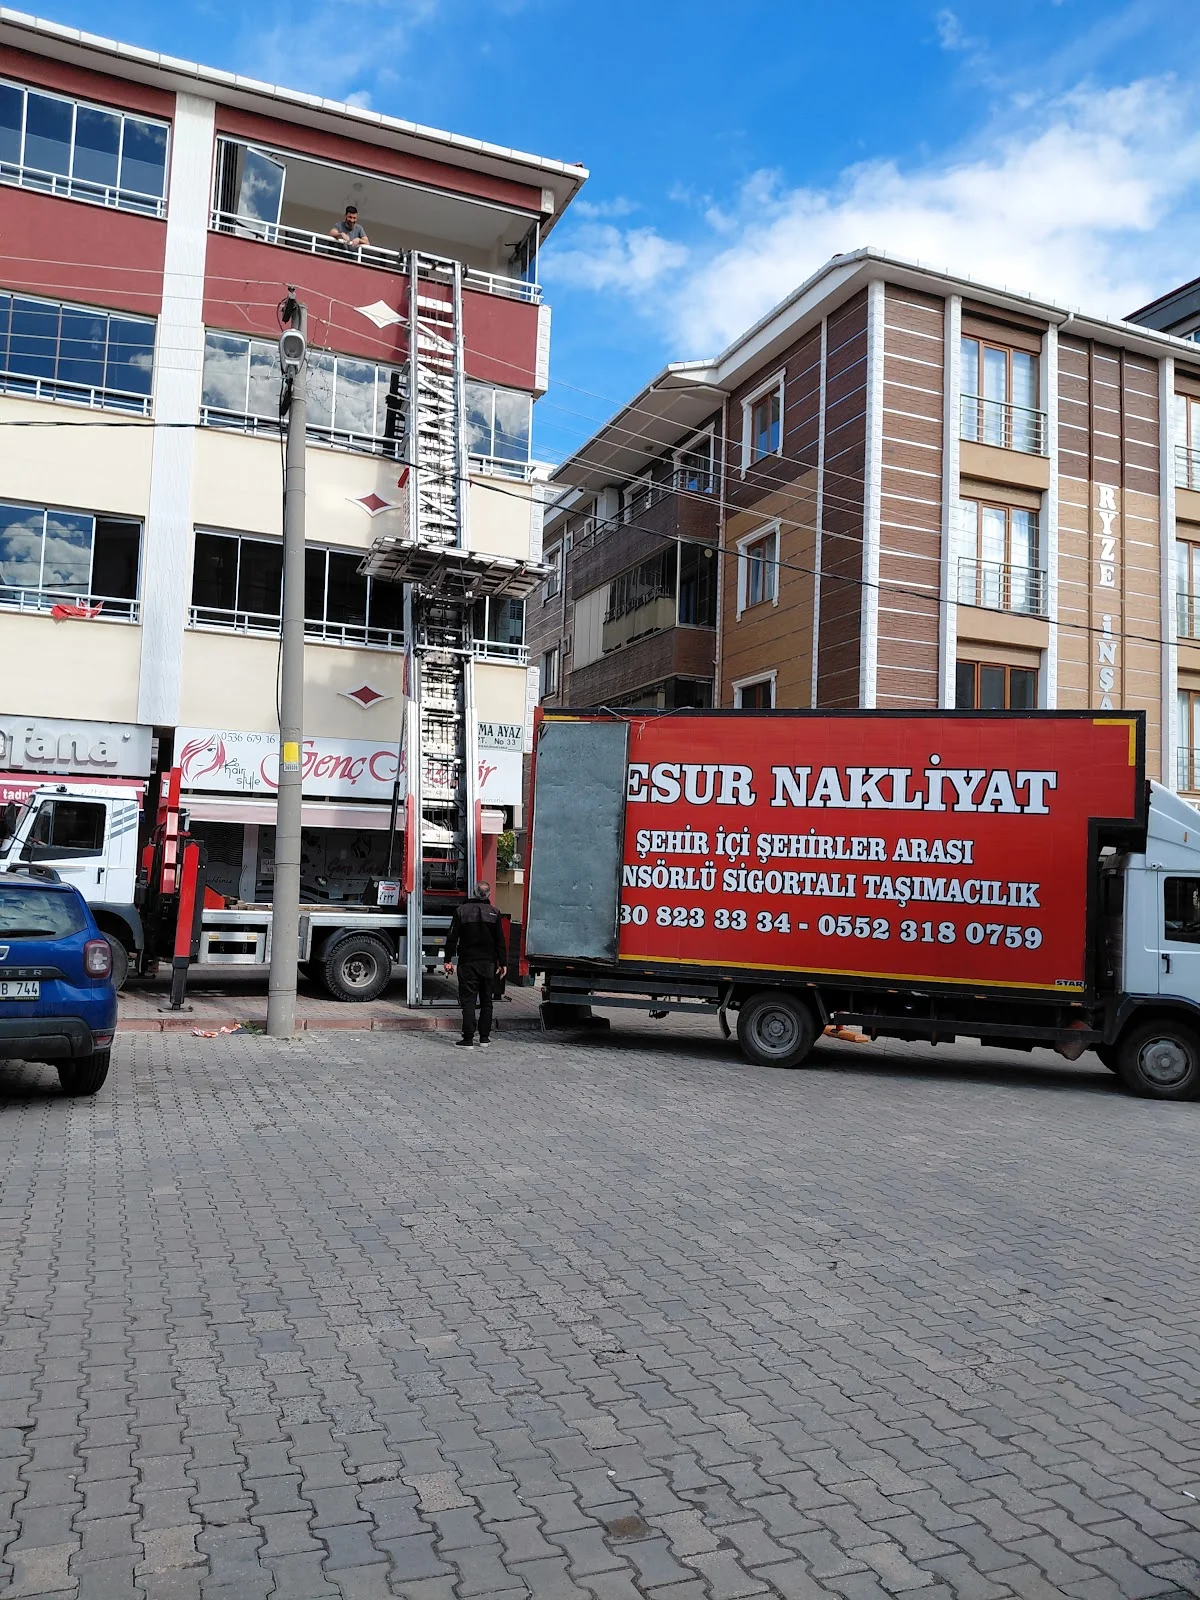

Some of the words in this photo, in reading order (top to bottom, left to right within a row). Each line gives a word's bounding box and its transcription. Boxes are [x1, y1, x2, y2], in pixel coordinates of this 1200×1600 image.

[1099, 485, 1116, 588] RYZE
[0, 720, 118, 768] fana
[221, 732, 243, 742] 0536
[247, 734, 262, 744] 679
[478, 724, 493, 736] MA
[497, 726, 521, 738] AYAZ
[224, 763, 246, 779] hair
[236, 770, 261, 790] style
[626, 762, 757, 806] ESUR
[770, 753, 1058, 814] NAKLİYAT
[636, 824, 709, 858] ŞEHİR
[715, 825, 751, 862] İÇİ
[756, 827, 886, 864] ŞEHİRLER
[892, 838, 975, 865] ARASI
[622, 860, 717, 892] NSÖRLÜ
[722, 862, 857, 899] SİGORTALI
[863, 874, 1041, 908] TAŞIMACILIK
[619, 905, 648, 926] 30
[656, 906, 705, 928] 823
[713, 908, 748, 931] 33
[756, 911, 791, 934] 34
[817, 914, 890, 940] 0552
[899, 919, 957, 944] 318
[965, 922, 1043, 950] 0759
[16, 982, 38, 995] 744
